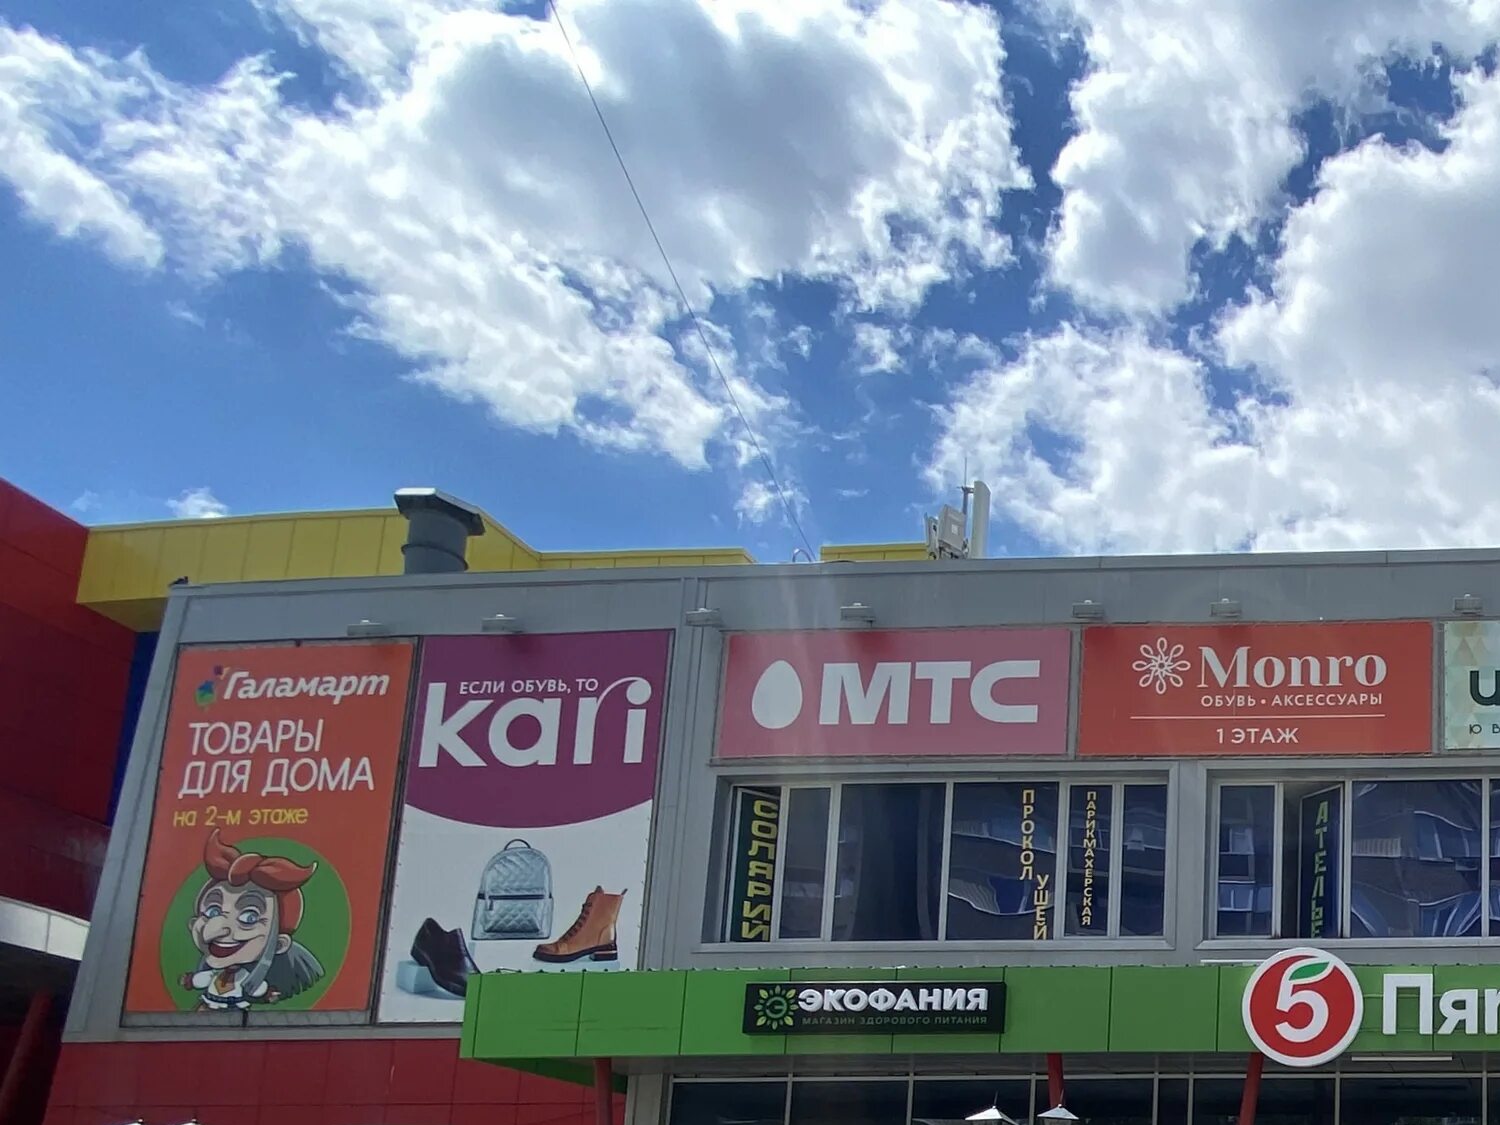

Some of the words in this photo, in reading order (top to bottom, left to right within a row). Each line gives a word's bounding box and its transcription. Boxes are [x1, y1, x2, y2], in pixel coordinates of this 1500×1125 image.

[223, 670, 390, 705] Галамарт
[459, 679, 505, 695] ЕСЛИ
[510, 679, 571, 696] ОБУВЬ,
[575, 678, 599, 693] ТО
[1196, 646, 1387, 688] Monro
[819, 660, 1040, 725] МТС
[1200, 695, 1256, 707] ОБУВЬ
[1271, 693, 1382, 707] АКСЕССУАРЫ
[188, 719, 323, 757] ТОВАРЫ
[418, 676, 653, 768] kari
[1216, 728, 1224, 744] 1
[1231, 727, 1299, 744] ЭТАЖ
[178, 759, 249, 799] ДЛЯ
[262, 757, 374, 796] ДОМА
[173, 810, 197, 827] на
[205, 806, 241, 826] 2-м
[248, 807, 308, 825] этаже
[1019, 789, 1035, 881] ПРОКОЛ
[741, 799, 778, 941] СОЛЯРИЙ
[1081, 791, 1097, 926] ПАРИКМАХЕРСКАЯ
[1311, 801, 1328, 938] АТЕЛЬЕ
[1033, 874, 1049, 940] УШЕЙ
[798, 987, 988, 1013] ЭКОФАНИЯ
[802, 1016, 856, 1025] МАГАЗИН
[859, 1016, 931, 1025] ЗДОРОВОГО
[934, 1015, 988, 1025] ПИТАНИЯ
[1274, 958, 1333, 1042] 5
